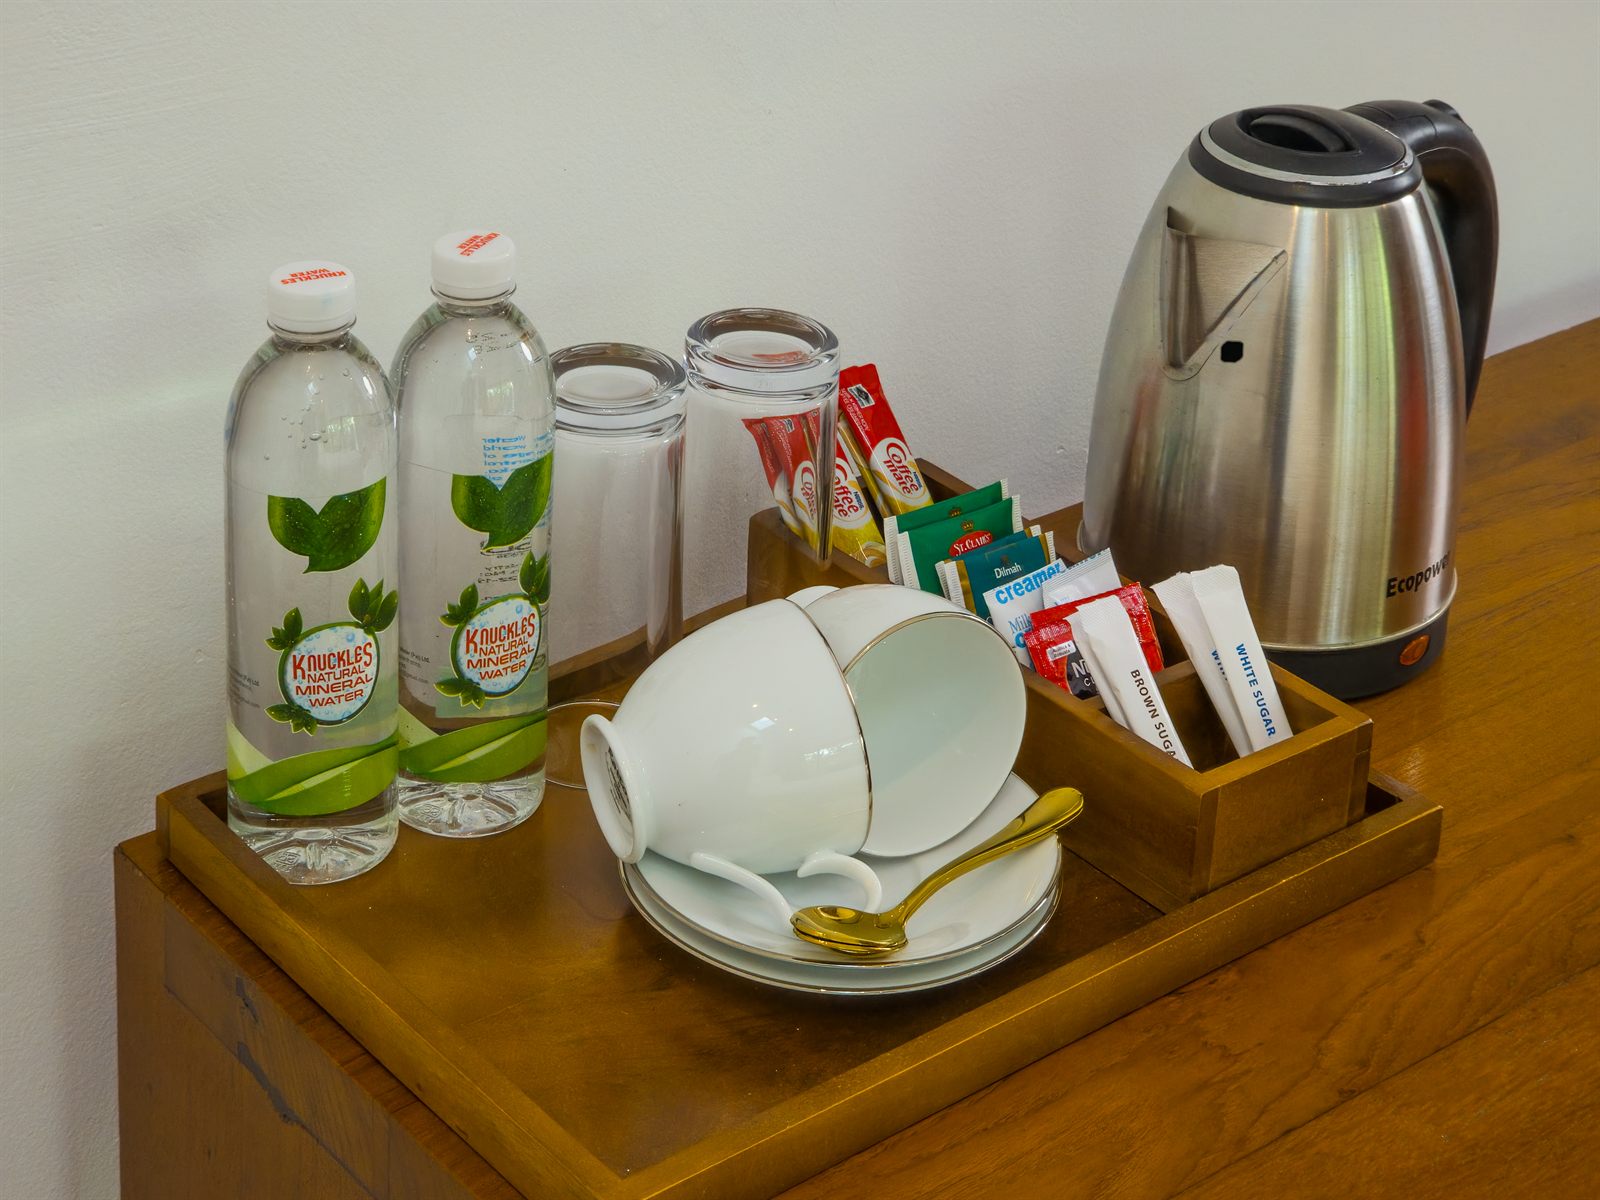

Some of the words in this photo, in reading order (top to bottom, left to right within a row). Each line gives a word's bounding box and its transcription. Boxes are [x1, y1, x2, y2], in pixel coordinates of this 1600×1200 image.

[459, 232, 500, 256] KNUCKLES
[280, 271, 346, 285] KNUCKLES
[289, 268, 330, 278] WATER
[886, 442, 919, 492] Coffee
[994, 563, 1022, 579] Dilmah
[995, 563, 1060, 604] creamer
[465, 613, 536, 654] KNUCKLES
[467, 645, 535, 669] MINERAL
[479, 637, 529, 657] NATURAL
[292, 642, 373, 680] KNUCKLES
[479, 660, 526, 680] WATER
[296, 674, 373, 695] MINERAL
[307, 665, 365, 683] NATURAL
[309, 689, 364, 707] WATER
[1235, 643, 1259, 687] WHITE
[1252, 690, 1276, 737] SUGAR
[1130, 669, 1160, 719] BROWN
[1154, 722, 1178, 760] SUGA
